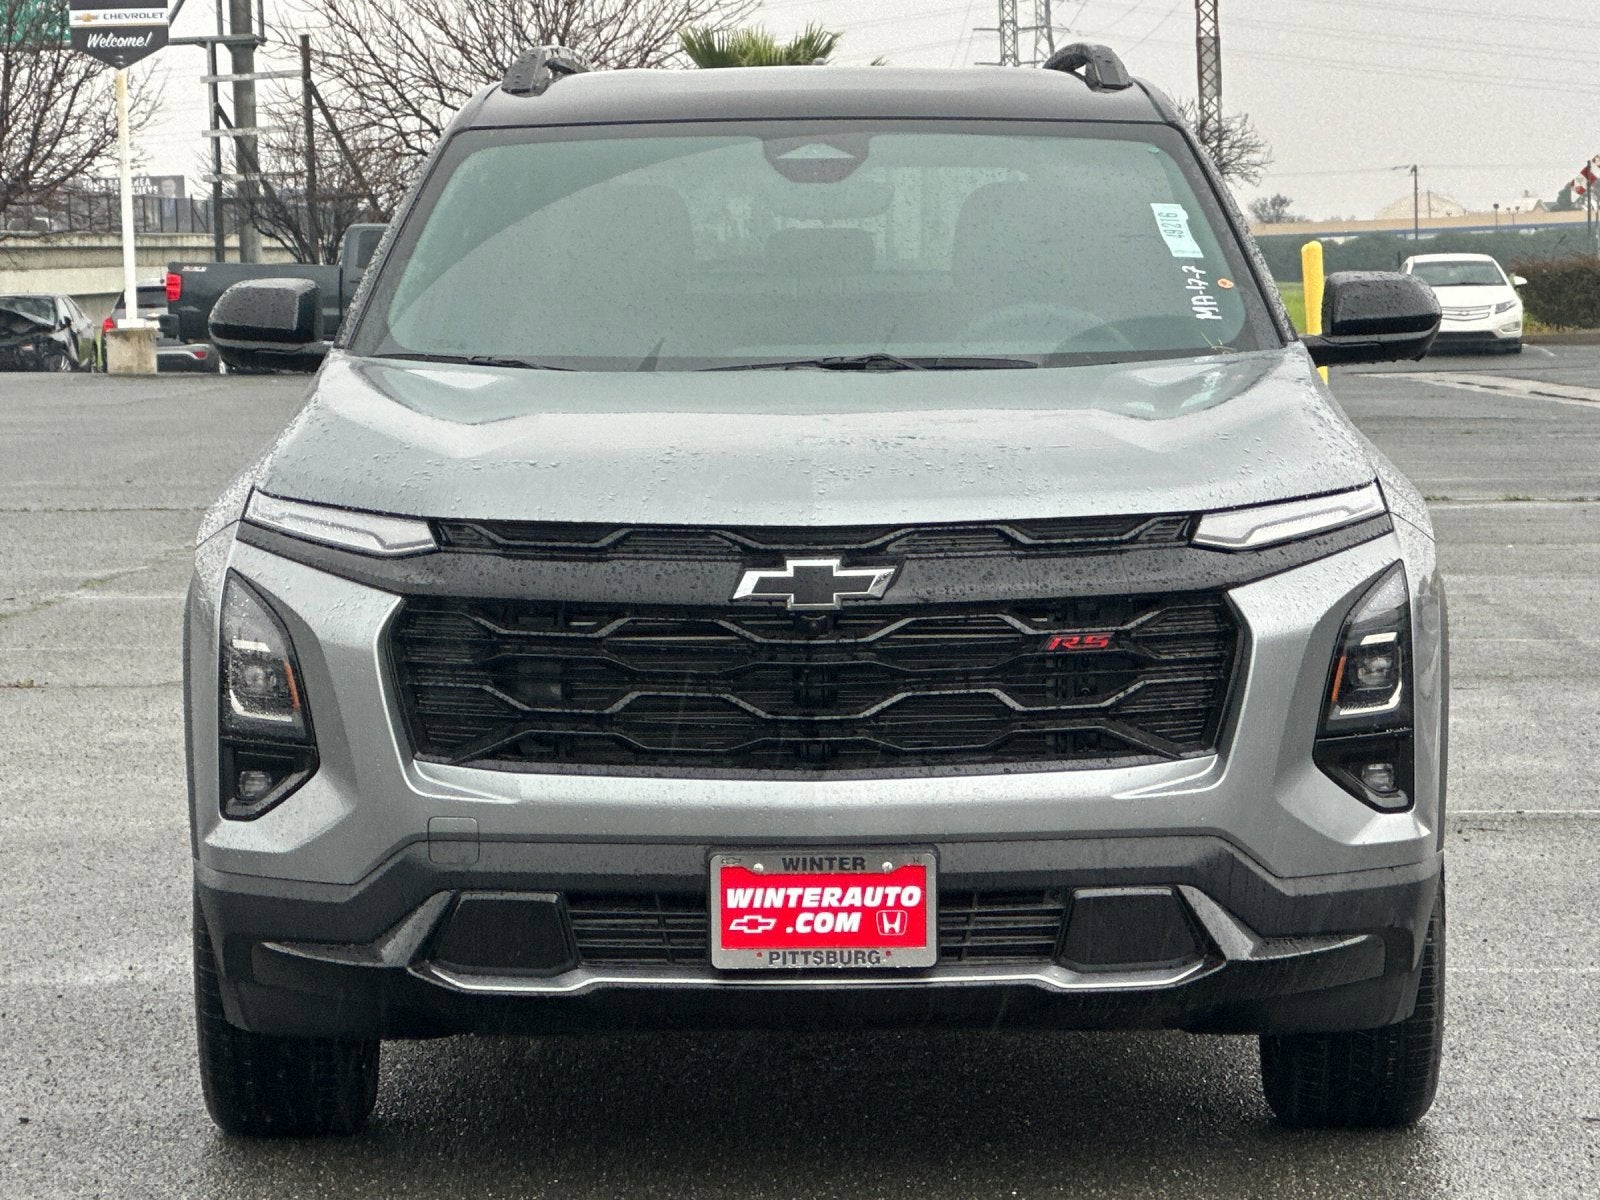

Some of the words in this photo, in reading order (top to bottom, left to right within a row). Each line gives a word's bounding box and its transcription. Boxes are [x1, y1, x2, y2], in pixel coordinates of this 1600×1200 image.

[103, 12, 164, 20] CHEVROLET
[87, 31, 153, 48] Welcome!
[1047, 635, 1109, 651] RS
[782, 856, 866, 872] WINTER
[726, 885, 922, 909] WINTERAUTO
[785, 912, 862, 934] .COM
[768, 950, 881, 966] PITTSBURG
